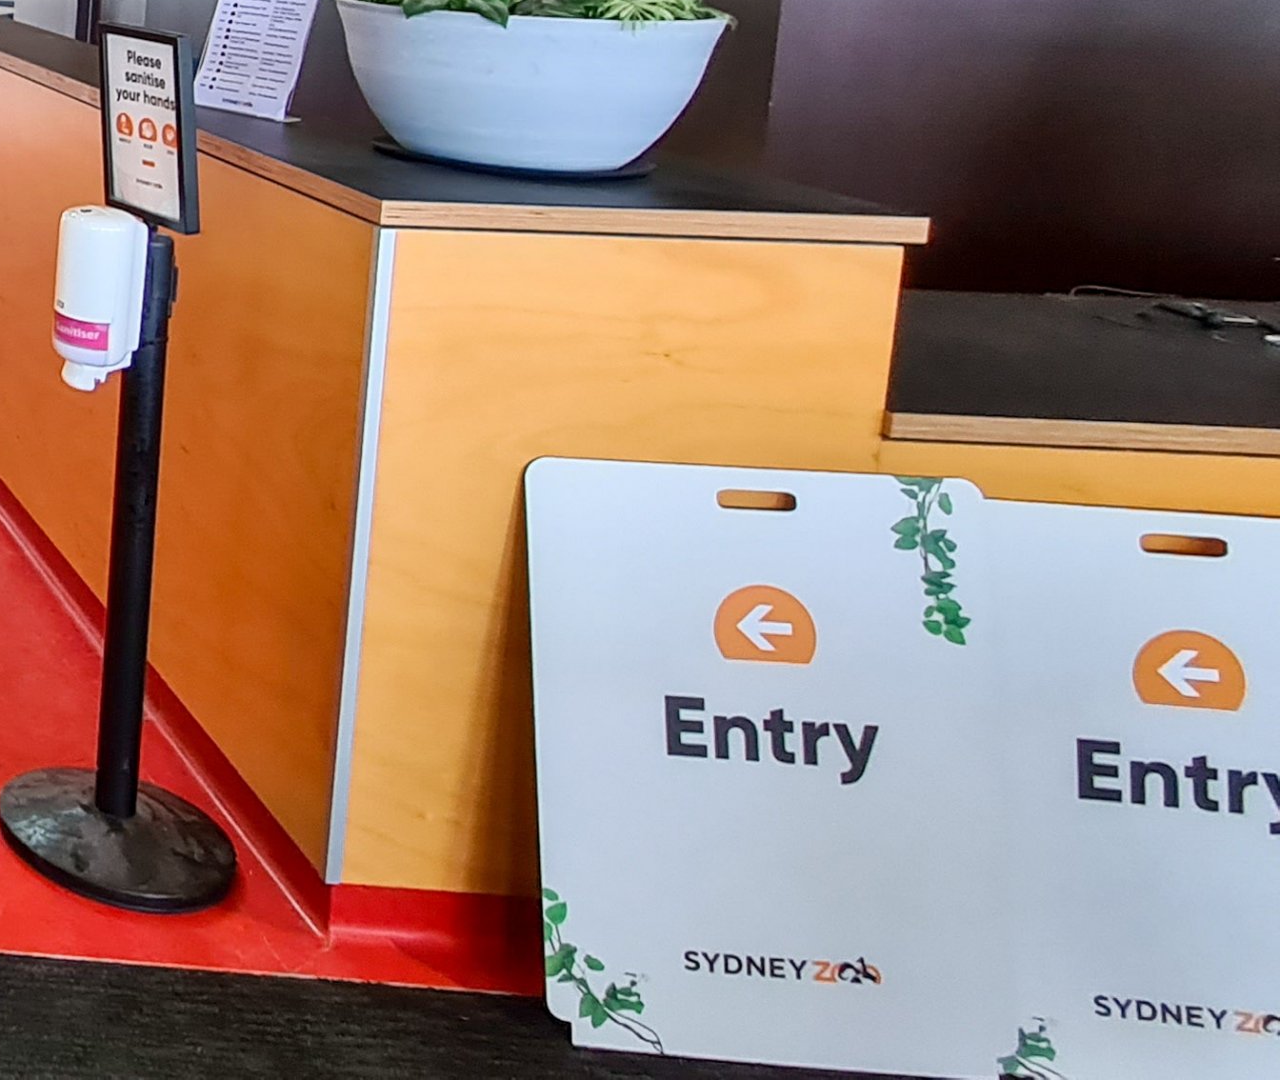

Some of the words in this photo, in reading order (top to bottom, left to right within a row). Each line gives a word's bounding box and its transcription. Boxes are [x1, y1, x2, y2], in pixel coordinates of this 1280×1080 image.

[127, 50, 161, 69] Please
[125, 71, 165, 89] sanitise
[115, 88, 141, 102] your
[143, 90, 176, 111] hands
[665, 695, 879, 785] Entry
[684, 950, 807, 980] SYDNEY
[1093, 995, 1228, 1029] SYDNEY
